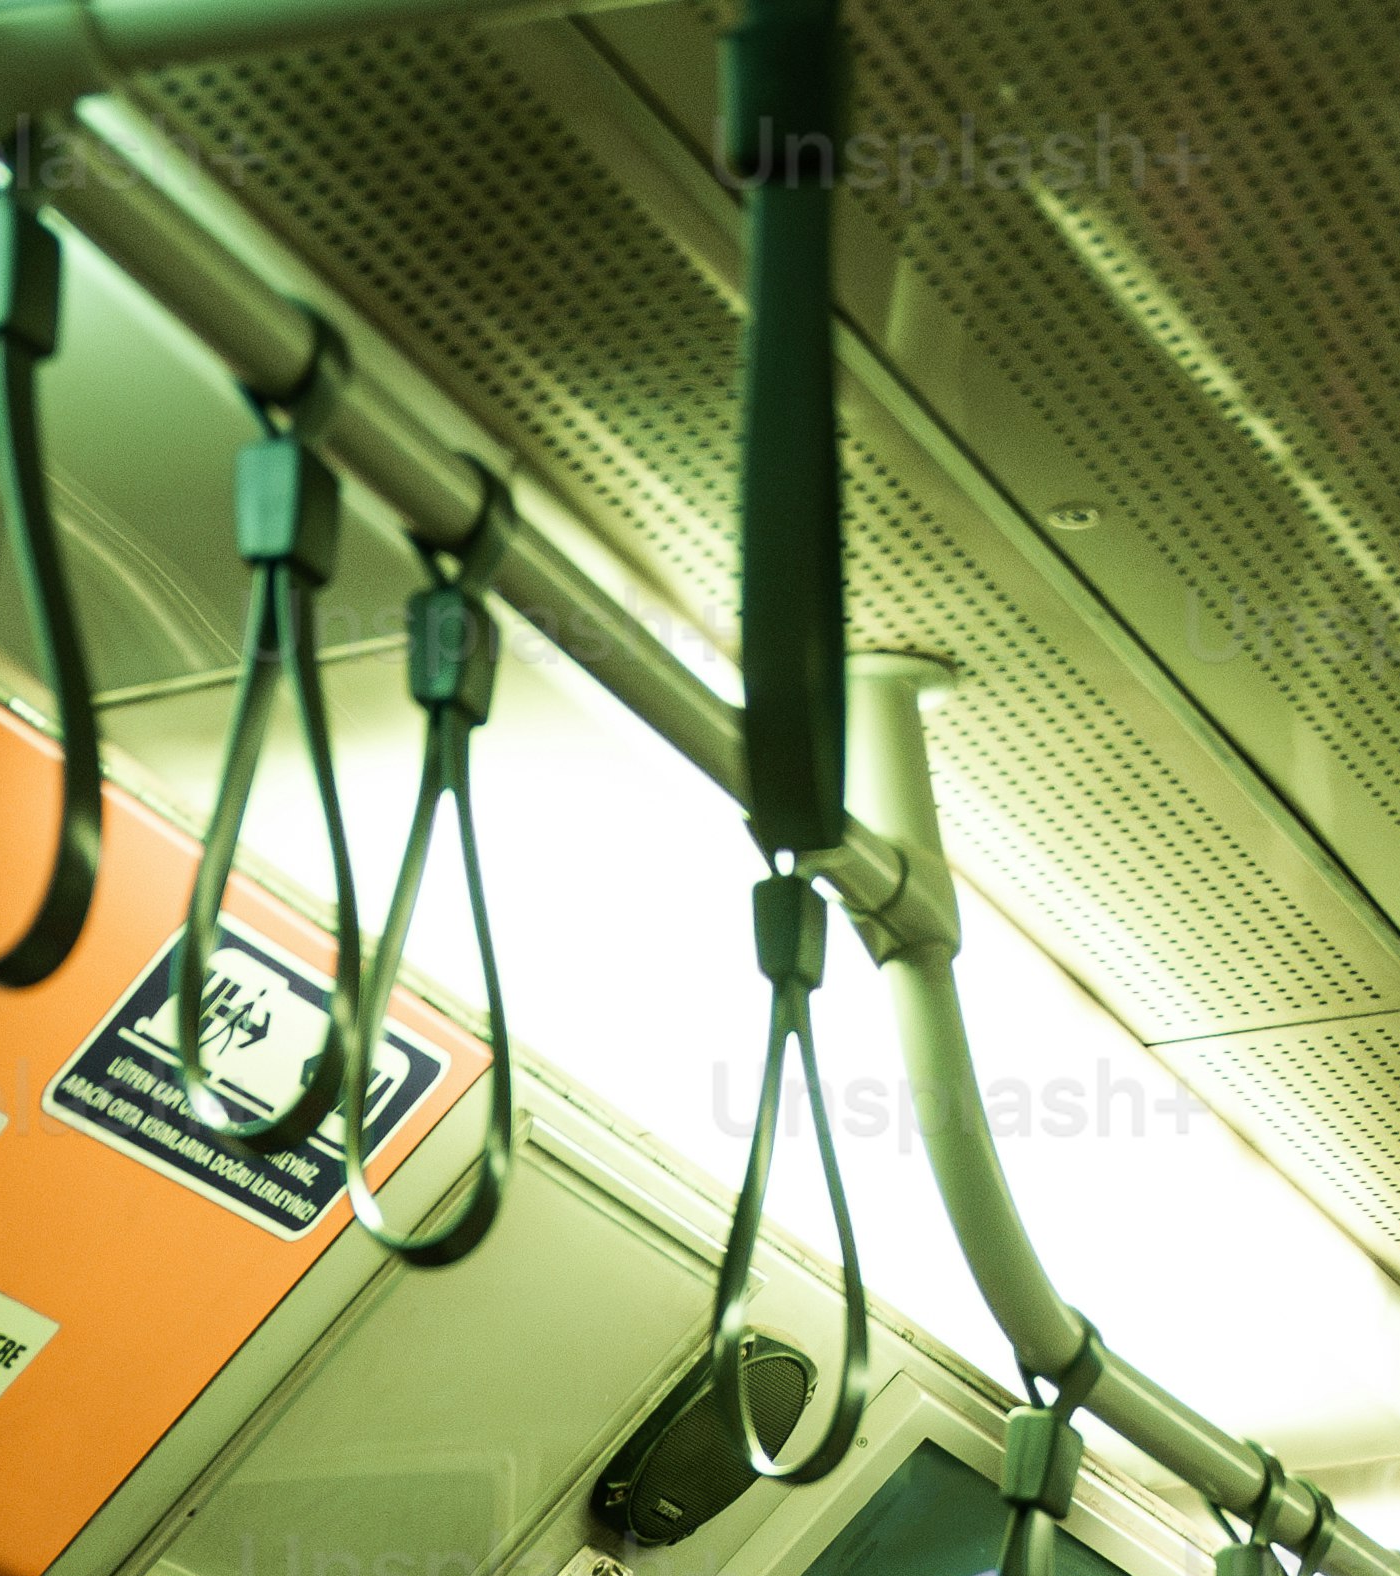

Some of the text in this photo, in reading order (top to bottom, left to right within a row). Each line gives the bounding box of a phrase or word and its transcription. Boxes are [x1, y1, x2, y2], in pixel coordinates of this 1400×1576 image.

[106, 1055, 158, 1095] LÜTFEN
[59, 1073, 115, 1112] ARACIN
[106, 1097, 145, 1129] ORTA
[137, 1114, 216, 1168] KISIMLARINA
[208, 1153, 258, 1189] DOĞRU
